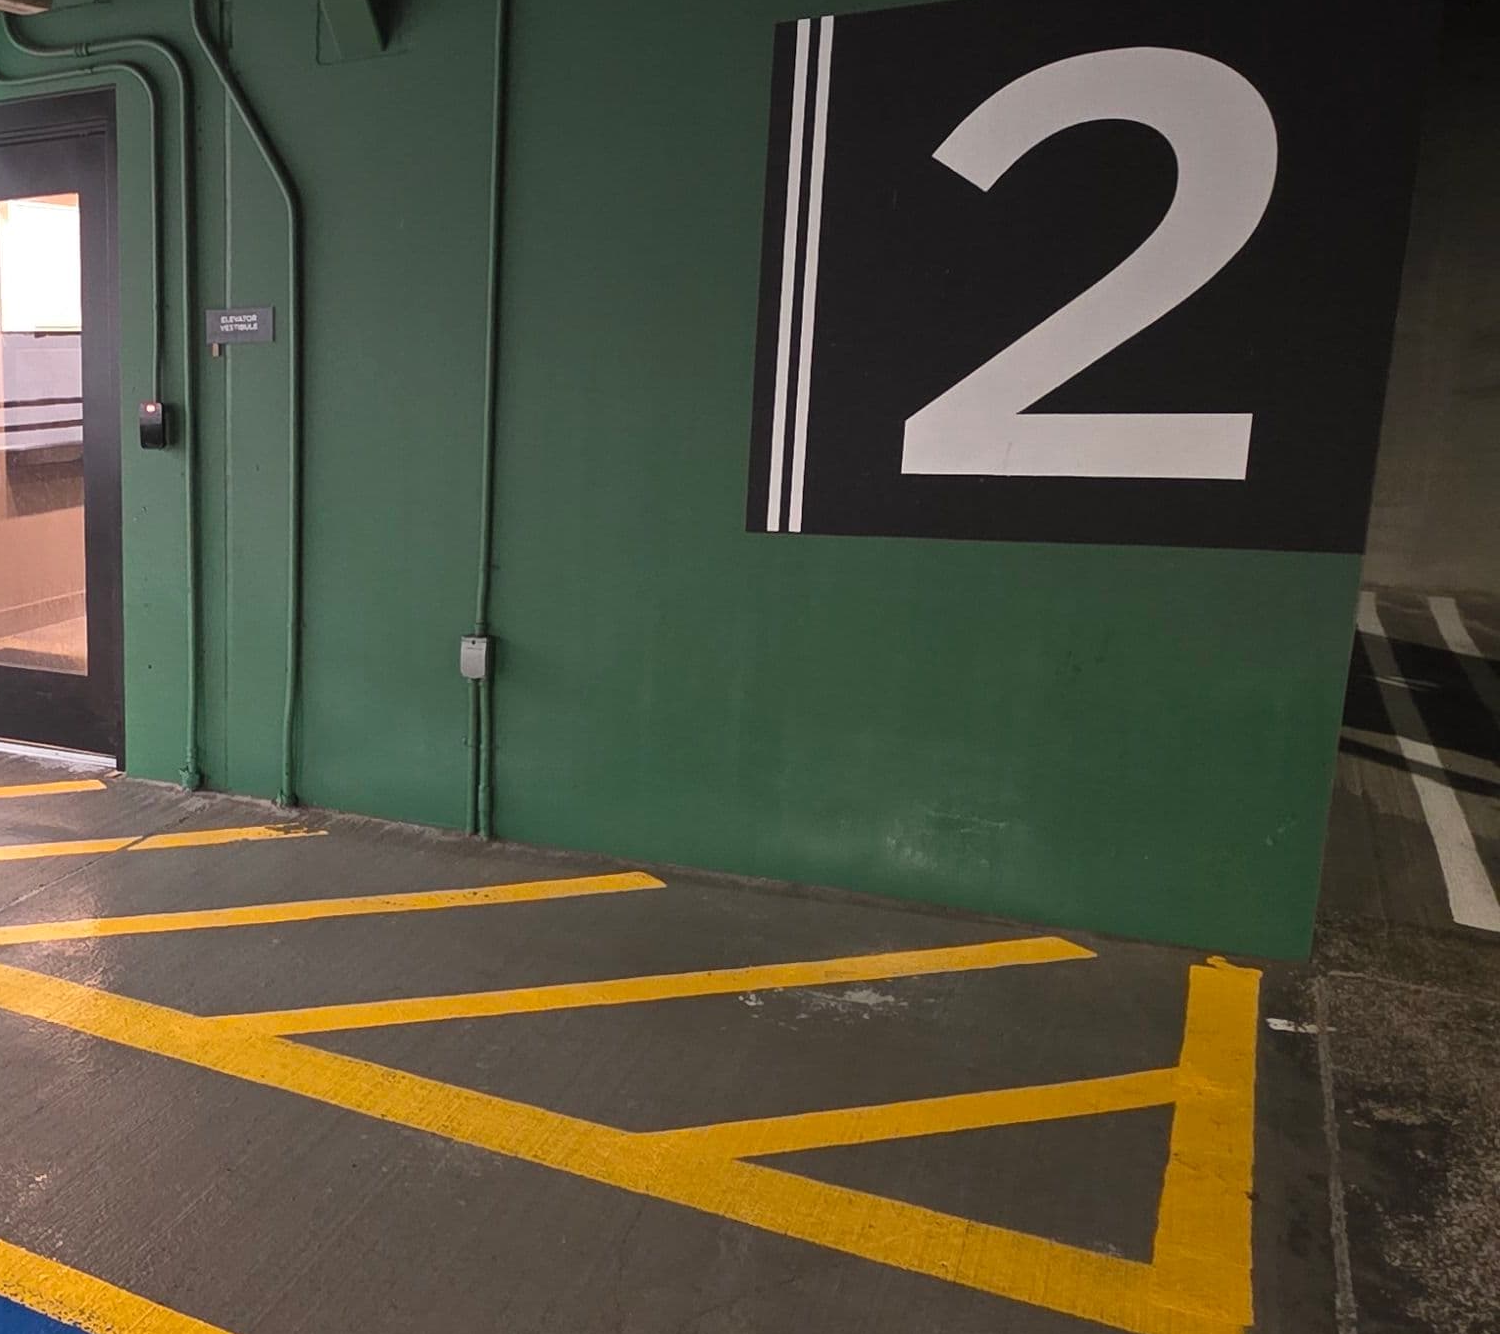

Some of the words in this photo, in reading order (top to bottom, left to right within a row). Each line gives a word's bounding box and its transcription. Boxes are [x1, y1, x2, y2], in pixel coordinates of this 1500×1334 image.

[901, 46, 1278, 480] 2
[220, 314, 258, 324] ELEVATOR
[219, 322, 258, 332] VESTIBULE
